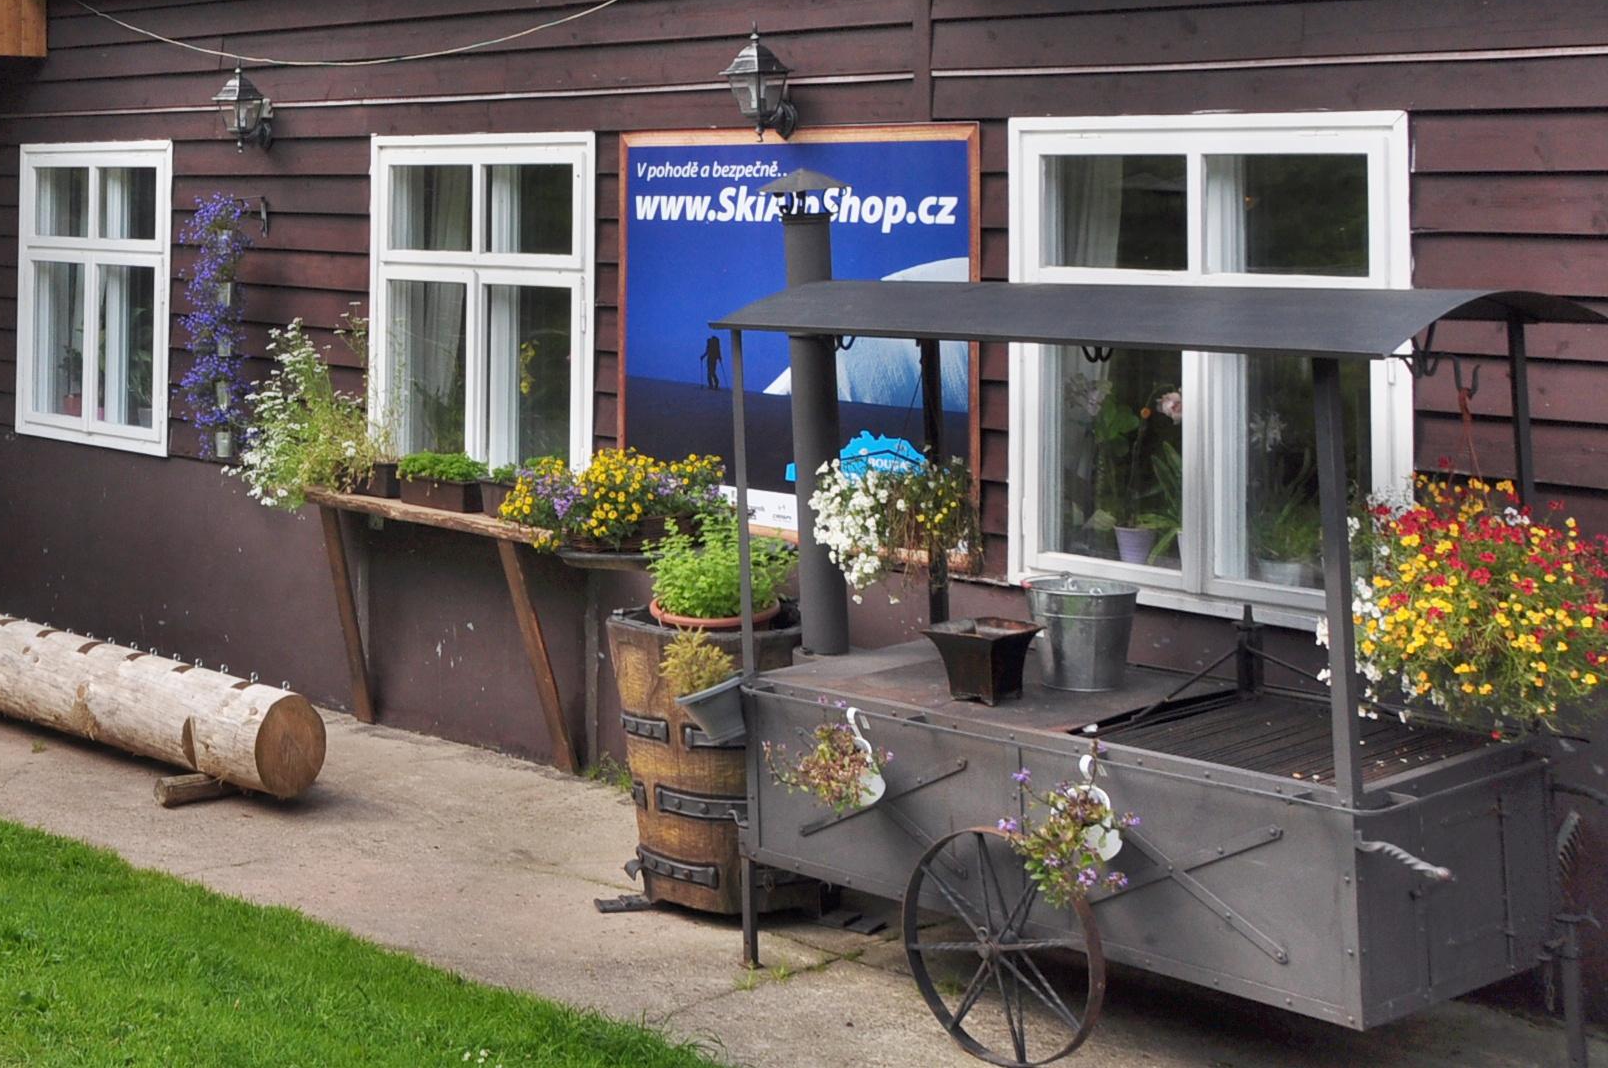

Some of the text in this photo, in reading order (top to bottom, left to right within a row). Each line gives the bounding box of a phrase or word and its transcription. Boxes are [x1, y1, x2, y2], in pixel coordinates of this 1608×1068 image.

[637, 162, 648, 178] V
[647, 161, 698, 182] pohodě
[700, 165, 710, 178] a
